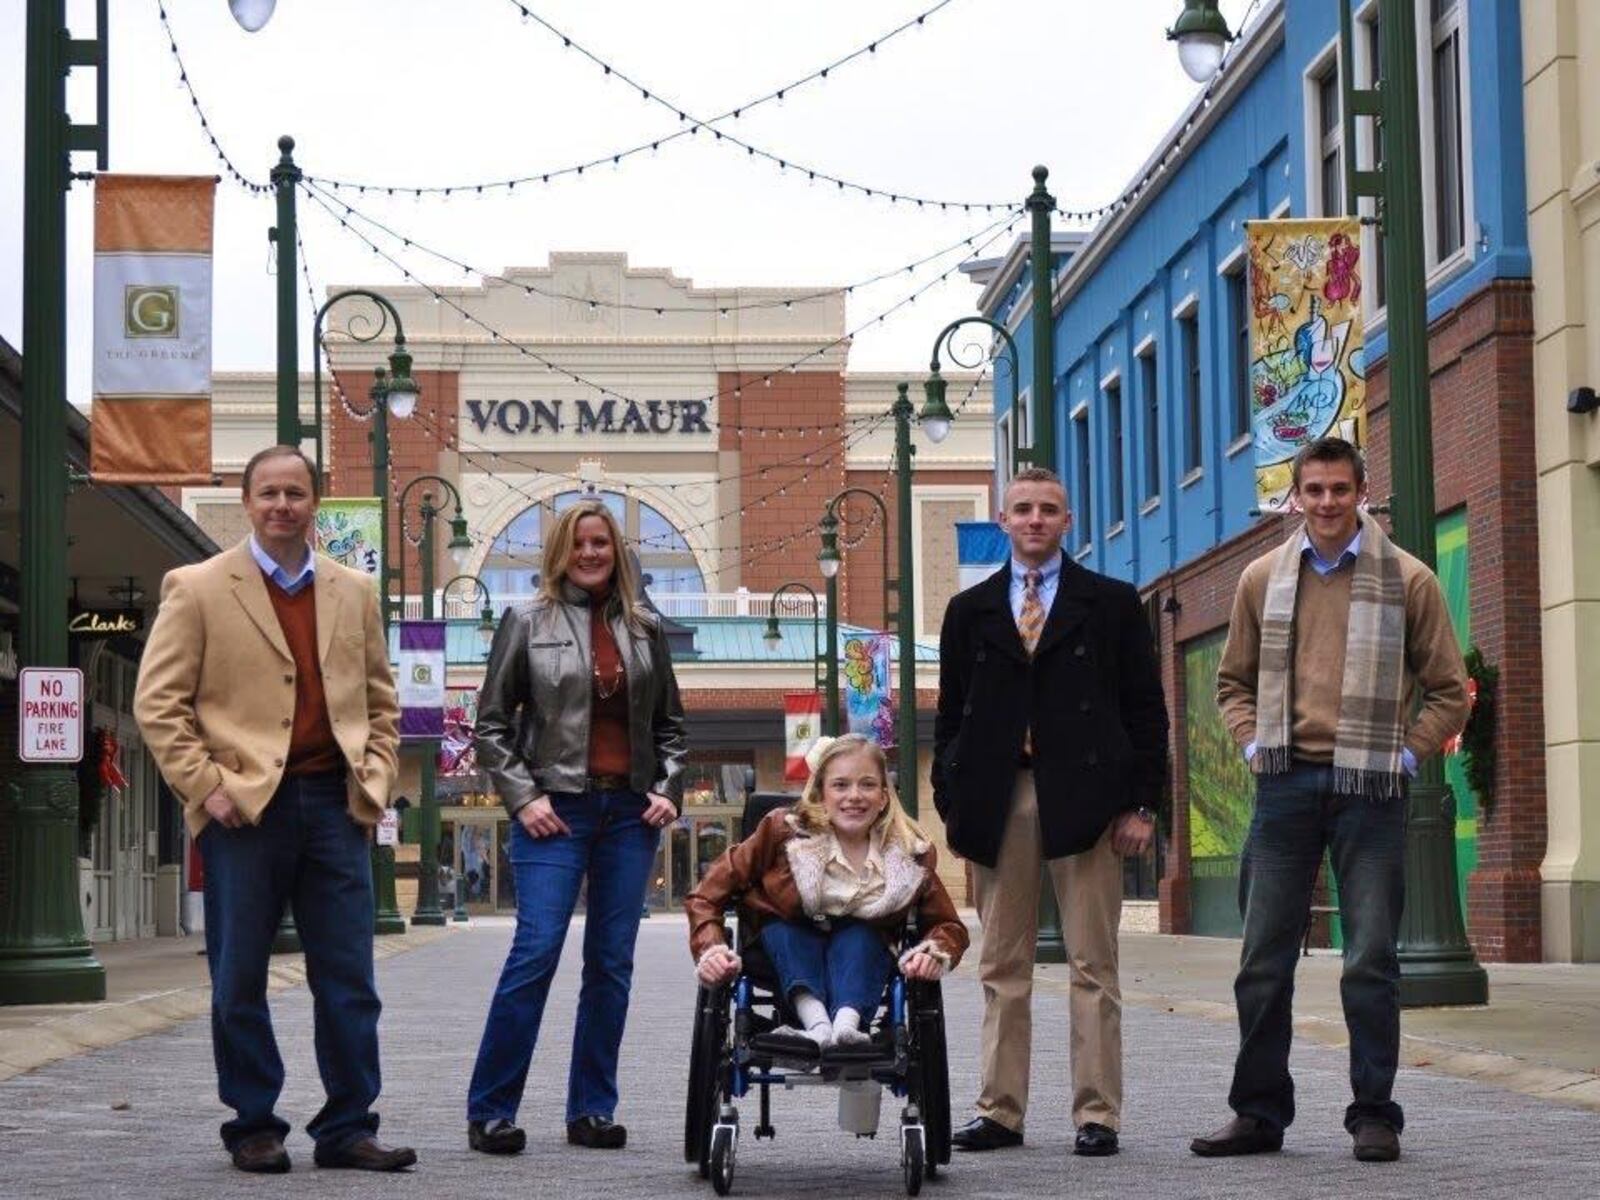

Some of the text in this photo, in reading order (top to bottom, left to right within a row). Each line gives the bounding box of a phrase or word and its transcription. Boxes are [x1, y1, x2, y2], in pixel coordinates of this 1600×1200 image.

[132, 291, 169, 331] G
[466, 399, 712, 434] VON MAUR
[68, 612, 136, 632] Clarks
[40, 680, 63, 697] NO
[26, 701, 78, 719] PARKING
[38, 723, 64, 734] FIRE
[36, 739, 66, 750] LANE
